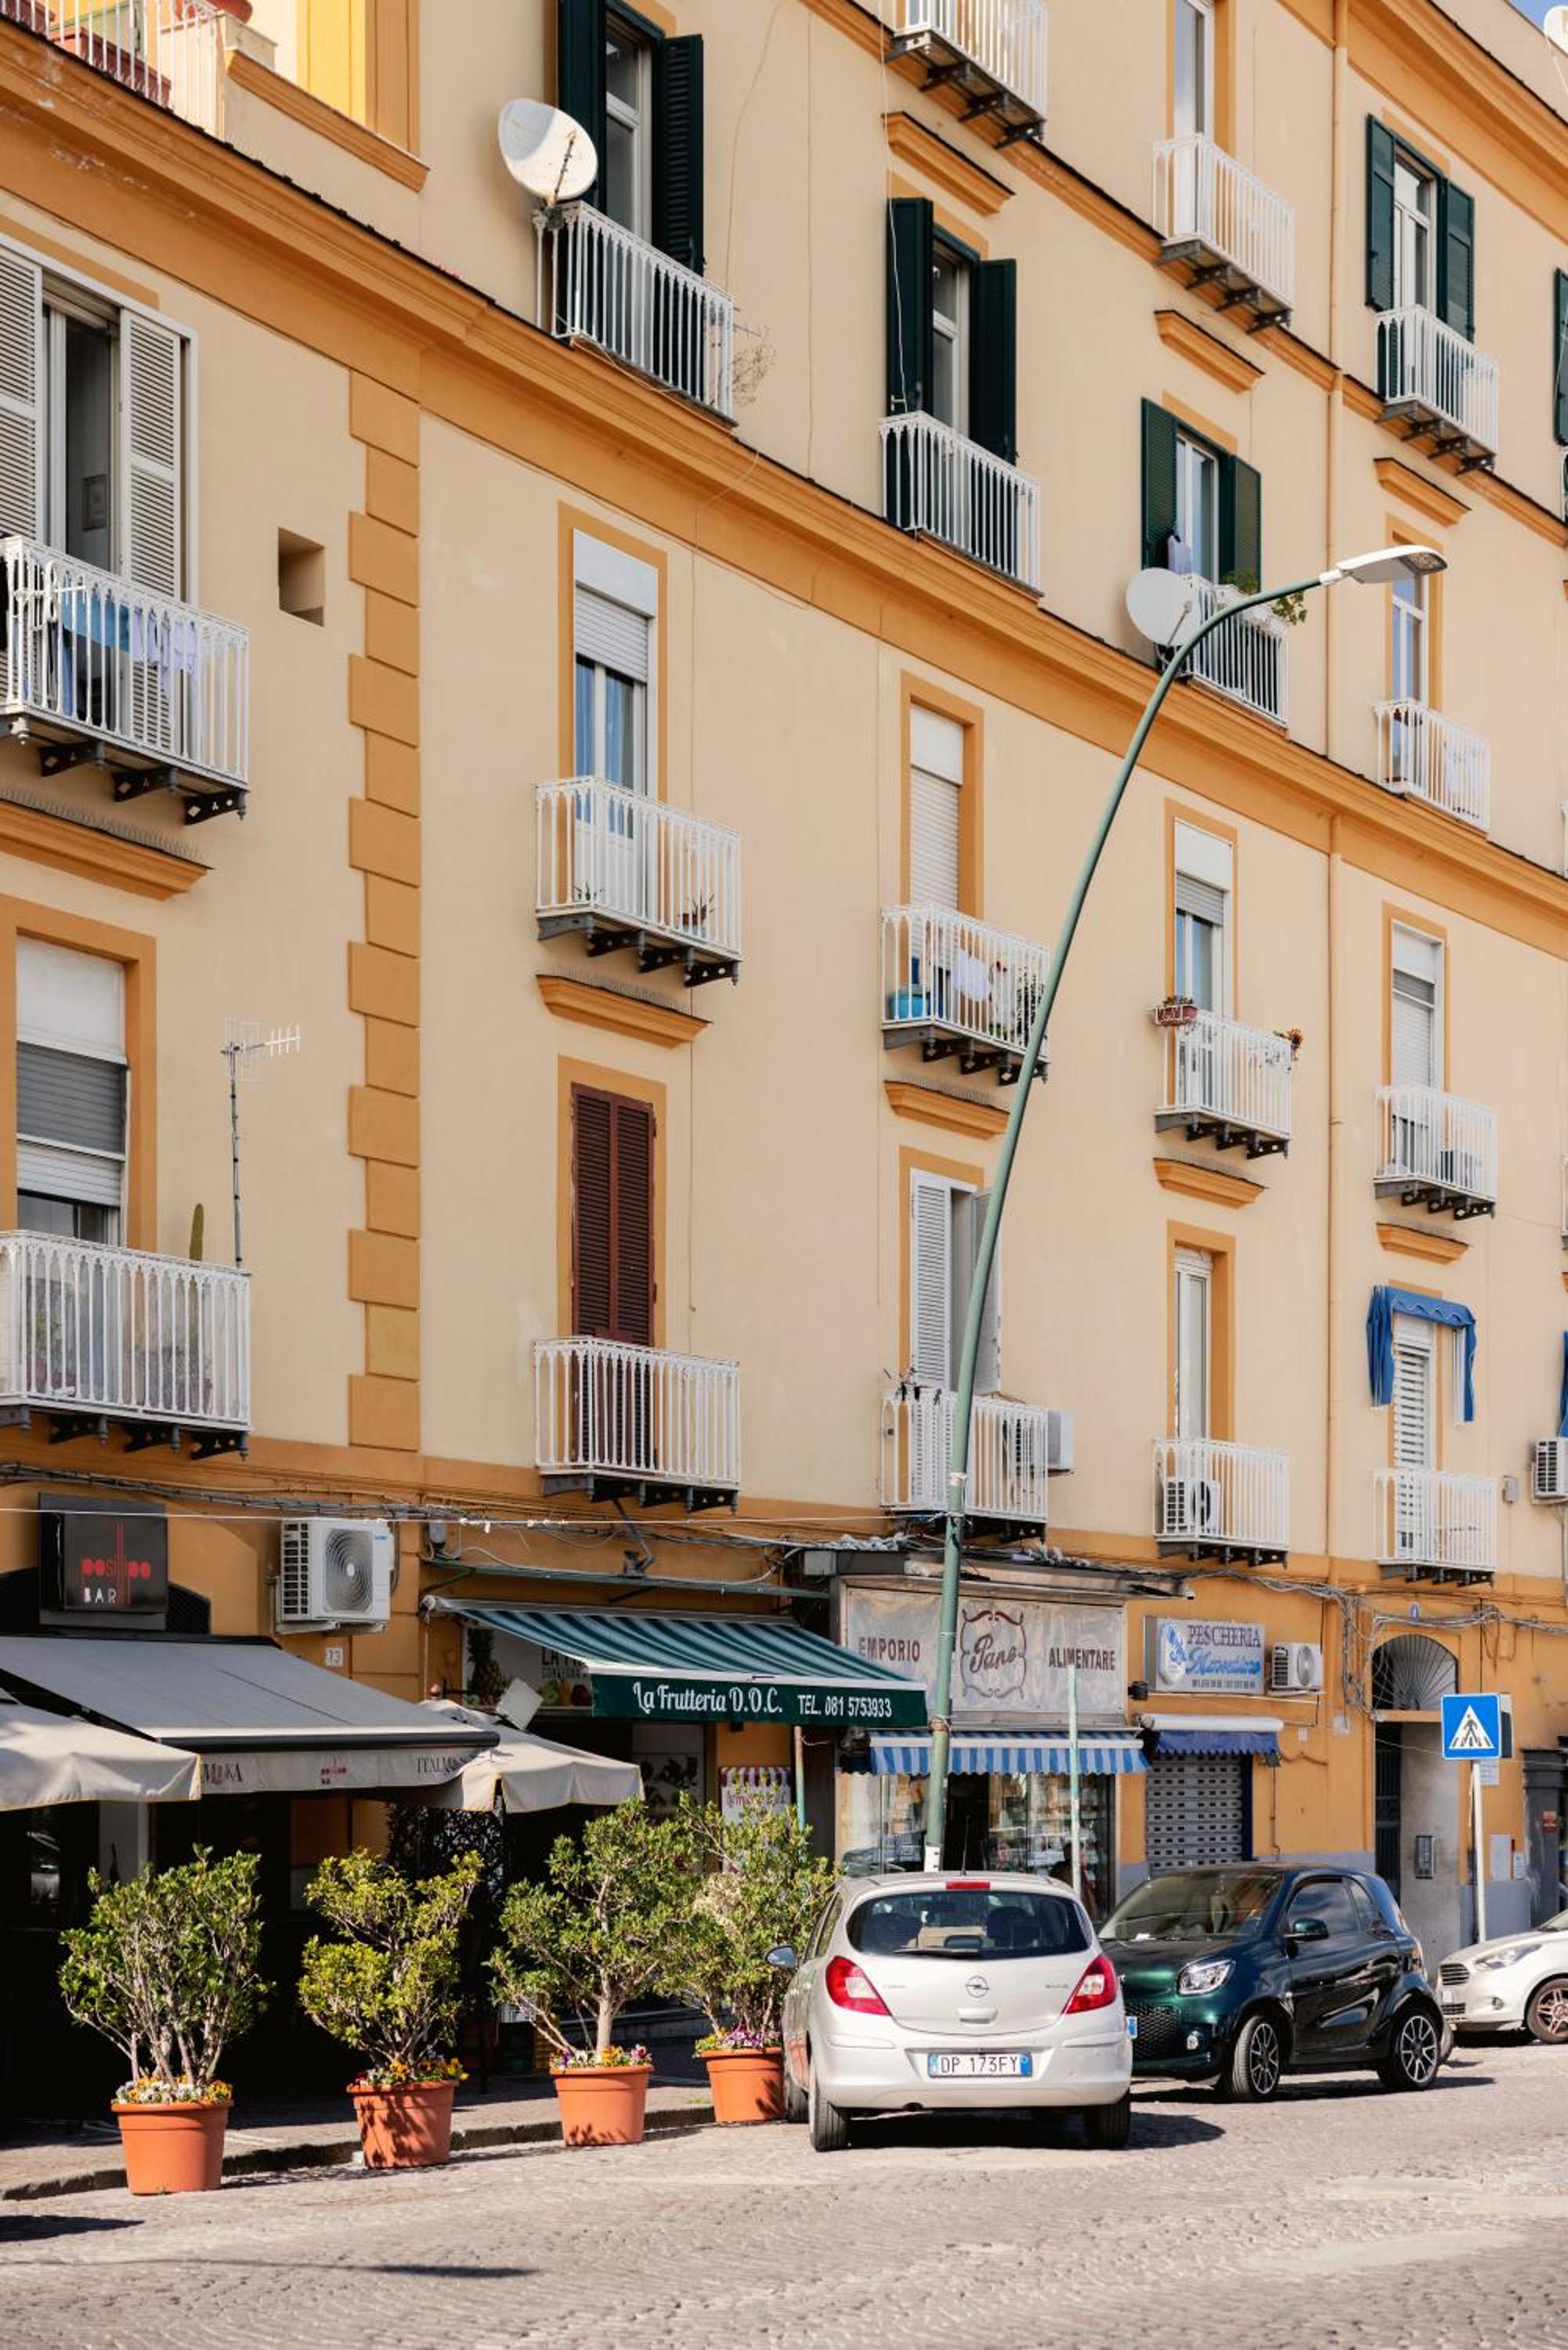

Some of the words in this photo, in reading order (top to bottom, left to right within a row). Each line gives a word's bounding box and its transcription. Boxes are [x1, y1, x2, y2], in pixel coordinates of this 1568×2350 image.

[84, 1587, 117, 1603] BAR
[1187, 1624, 1261, 1647] PESCHERIA
[858, 1636, 920, 1662] EMPORIO
[970, 1633, 1017, 1673] Pane
[1049, 1647, 1115, 1671] ALIMENTARE
[633, 1682, 655, 1715] La
[657, 1684, 727, 1712] Frutteria
[729, 1687, 782, 1713] D.O.C.
[797, 1694, 822, 1716] TEL.
[825, 1696, 844, 1716] 081
[848, 1697, 892, 1718] 5753933
[941, 2056, 961, 2073] DP
[969, 2056, 1018, 2073] 173FY
